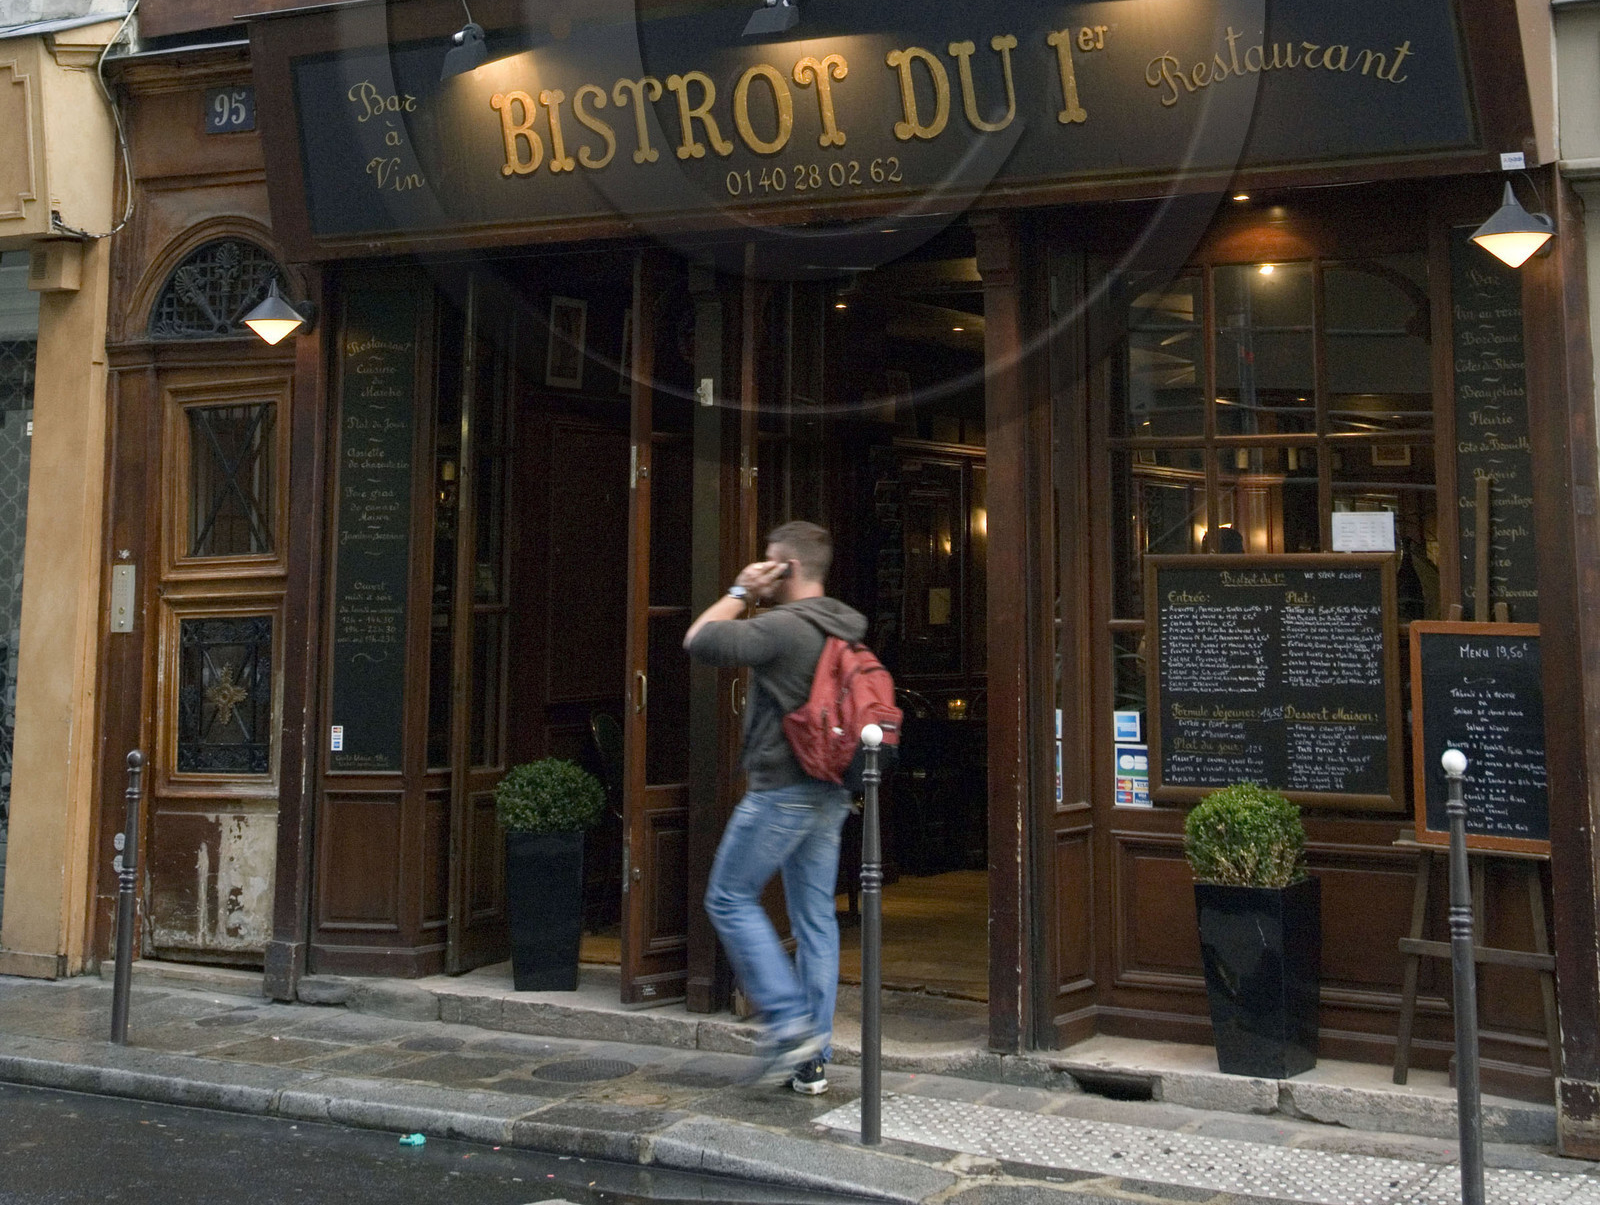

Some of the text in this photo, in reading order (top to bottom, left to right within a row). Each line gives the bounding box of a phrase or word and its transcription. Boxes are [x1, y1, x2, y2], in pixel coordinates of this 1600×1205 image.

[1143, 26, 1415, 107] Restaurant
[214, 91, 247, 127] 95
[347, 79, 417, 122] Bar
[491, 52, 849, 177] BISTROT
[885, 34, 1019, 141] DU
[385, 123, 404, 146] à
[366, 157, 425, 192] Vin
[793, 164, 822, 190] 28
[828, 160, 863, 187] 02
[870, 157, 903, 183] 62
